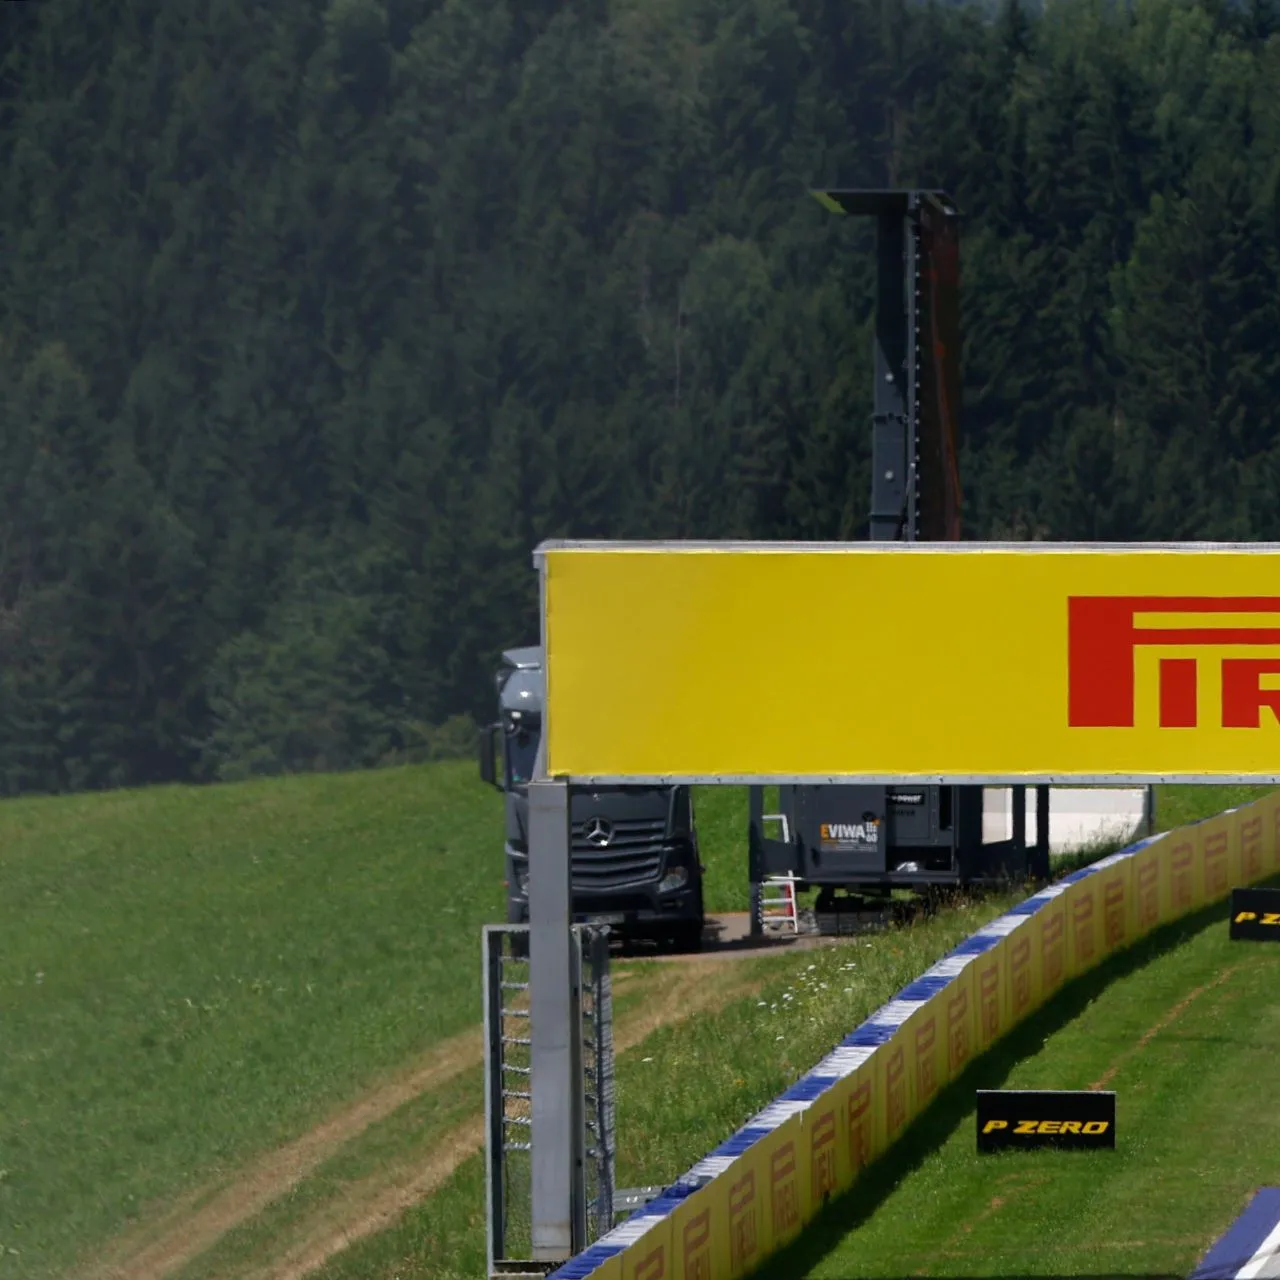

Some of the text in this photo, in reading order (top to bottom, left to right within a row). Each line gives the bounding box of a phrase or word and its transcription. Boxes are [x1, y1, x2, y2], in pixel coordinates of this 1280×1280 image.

[1235, 912, 1257, 923] P
[982, 1120, 1109, 1135] P ZERO
